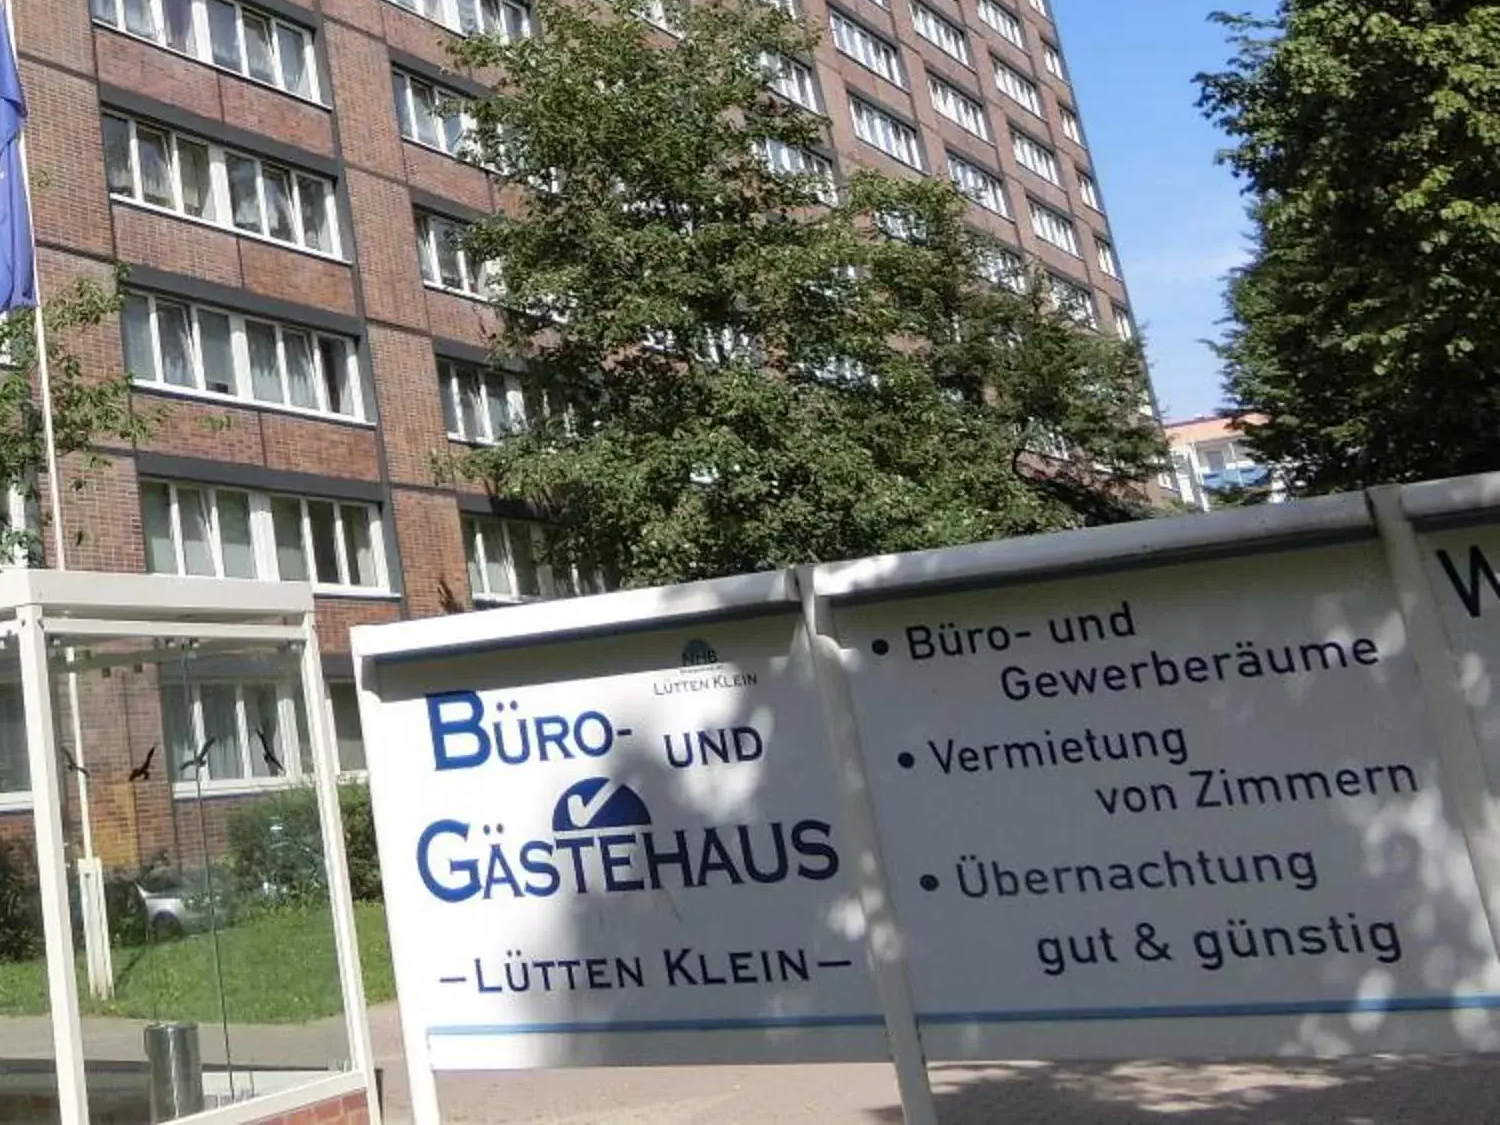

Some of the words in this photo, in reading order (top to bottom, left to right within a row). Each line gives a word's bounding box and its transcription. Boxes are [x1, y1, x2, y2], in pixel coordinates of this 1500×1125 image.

[907, 621, 1031, 660] Büro-
[1049, 602, 1136, 645] und
[653, 676, 709, 695] LÜTTEN
[713, 672, 757, 689] KLEIN
[1001, 638, 1380, 700] Gewerberäume
[426, 690, 632, 771] BÜRO-
[664, 725, 764, 769] UND
[928, 726, 1189, 774] Vermietung
[1096, 782, 1178, 814] von
[1188, 762, 1418, 807] Zimmern
[416, 819, 839, 902] GÄSTEHAUS
[956, 848, 1319, 897] Übernachtung
[1037, 929, 1118, 976] gut
[1134, 922, 1171, 962] &
[1192, 912, 1402, 971] günstig
